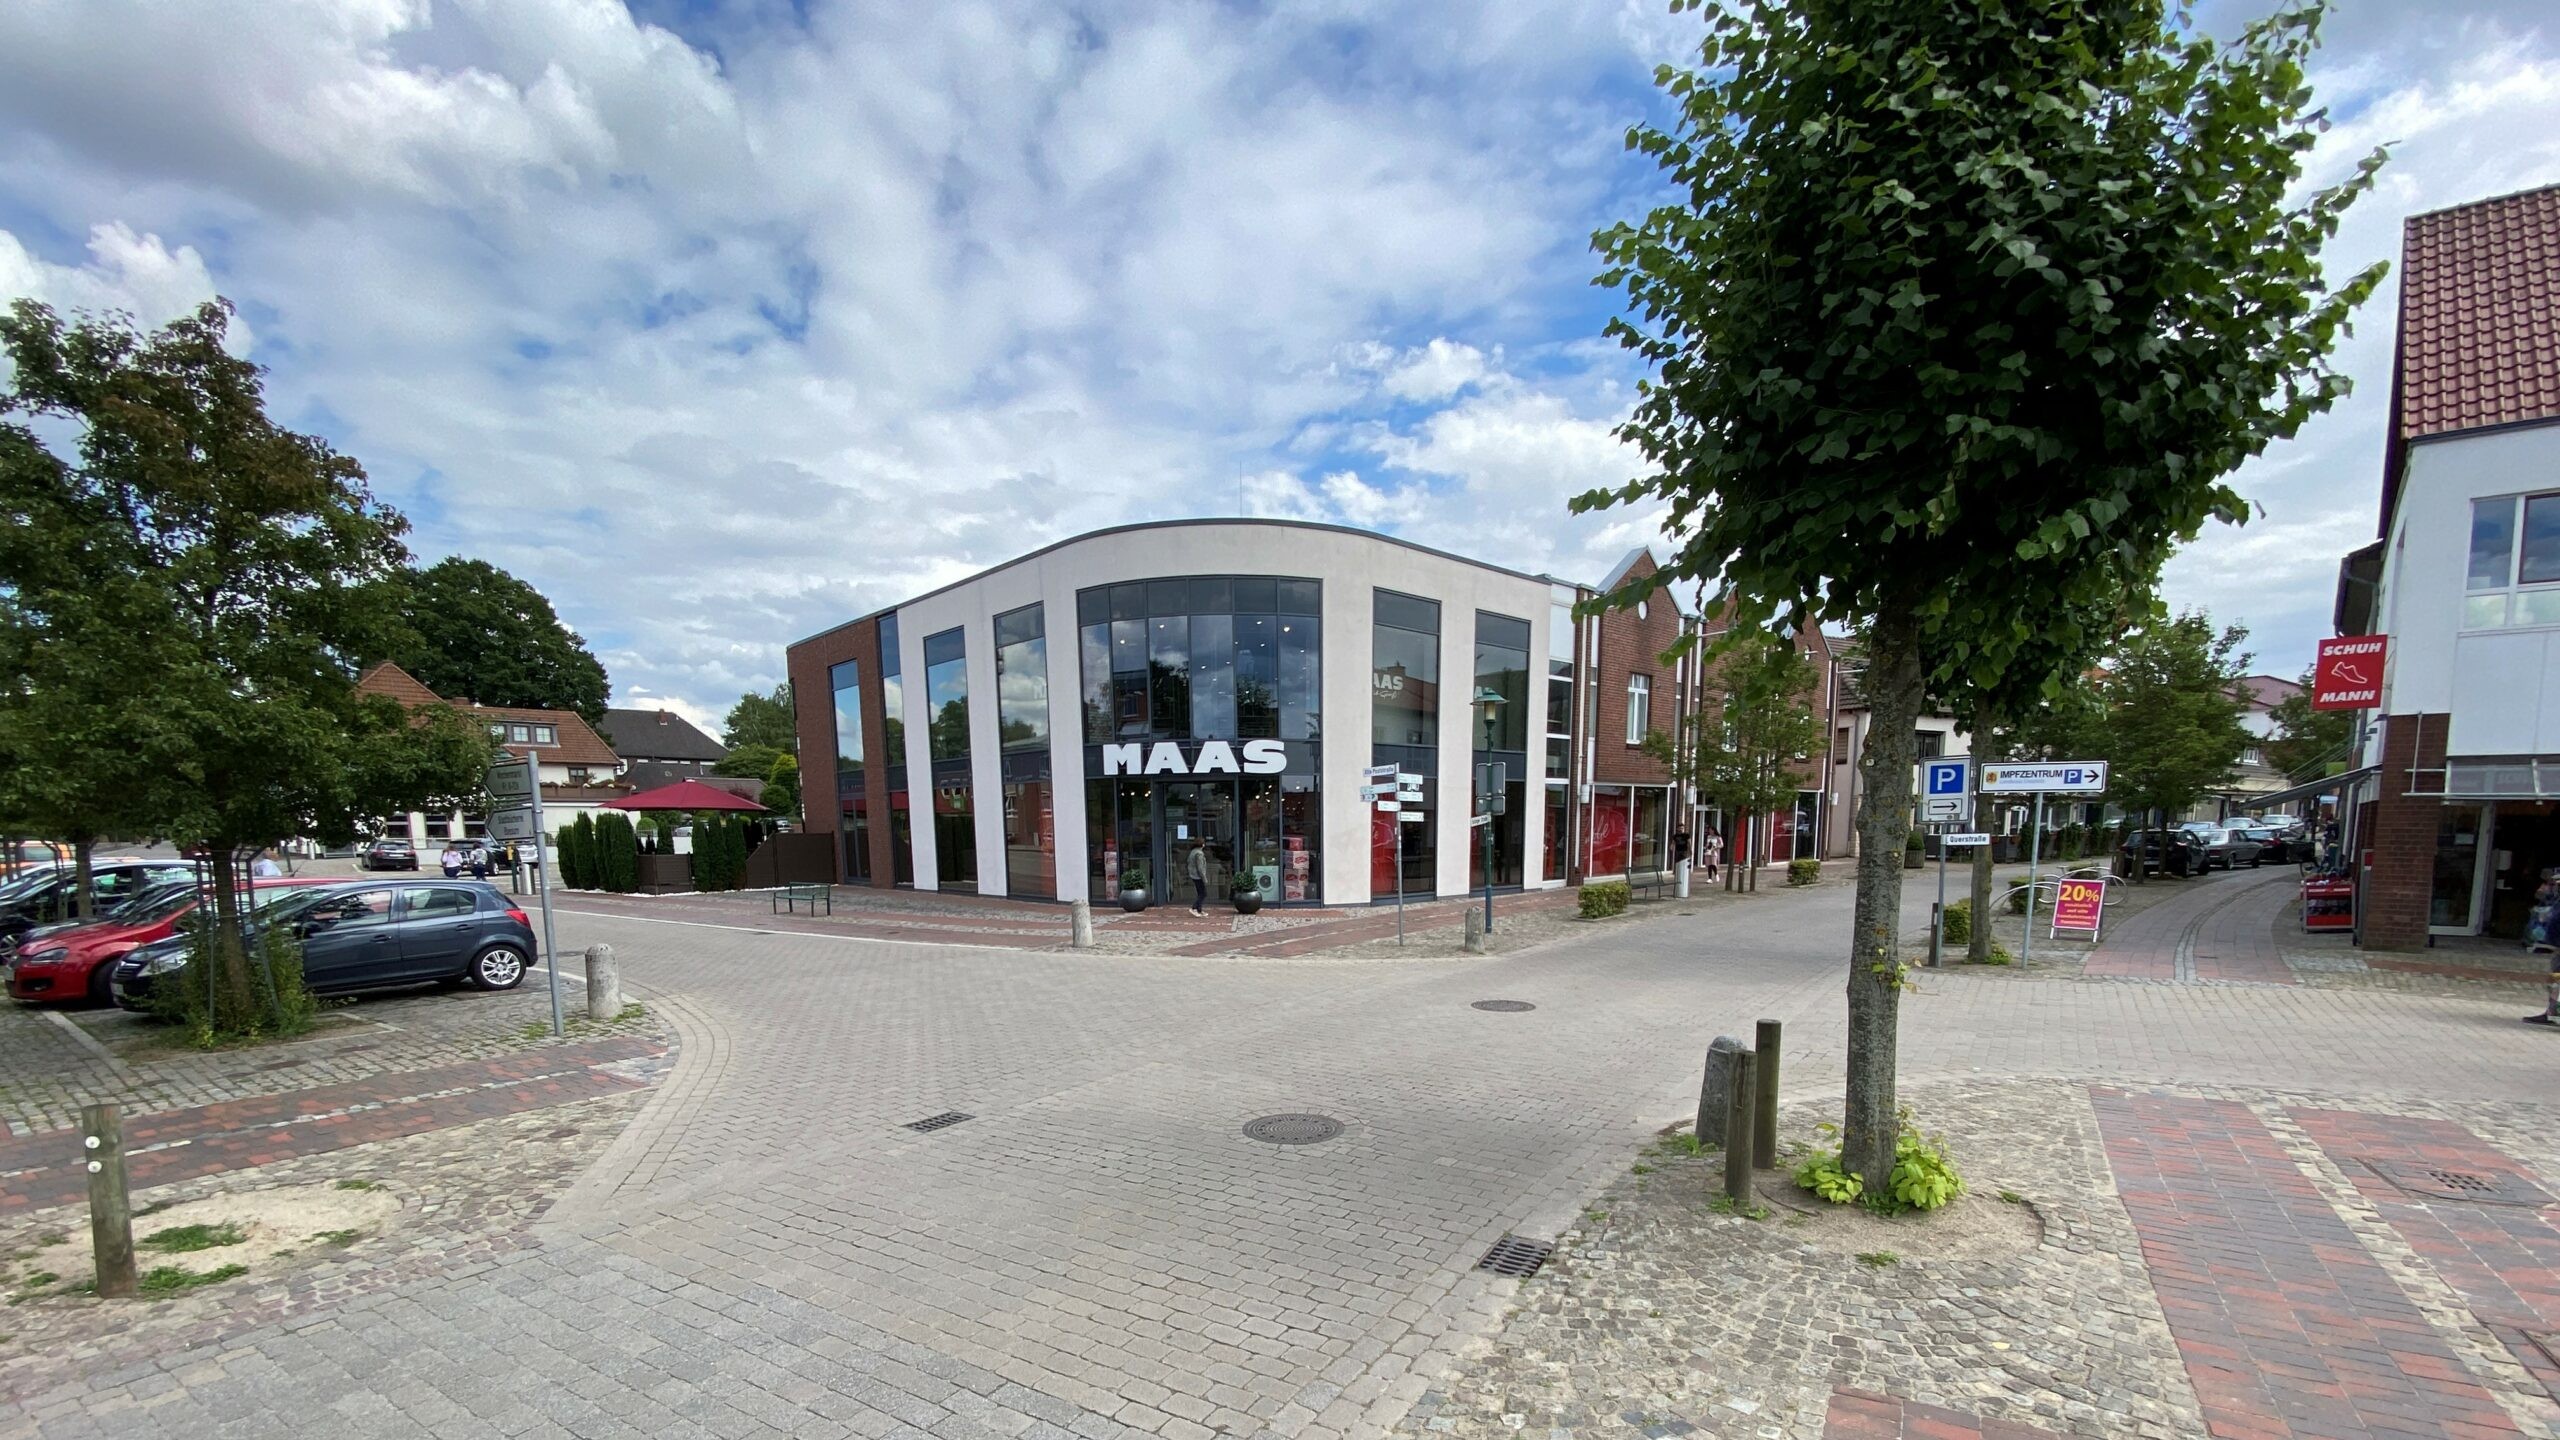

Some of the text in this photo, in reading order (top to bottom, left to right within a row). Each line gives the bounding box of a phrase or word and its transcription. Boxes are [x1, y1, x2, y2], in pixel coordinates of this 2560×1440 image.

[2322, 642, 2382, 656] SCHUH
[2320, 690, 2376, 703] MANN
[1102, 739, 1288, 776] MAAS
[1937, 768, 1956, 791] P
[2000, 769, 2078, 783] IMPFZENTRUM P
[1949, 835, 1987, 843] Querstraße
[2059, 884, 2100, 902] 20%
